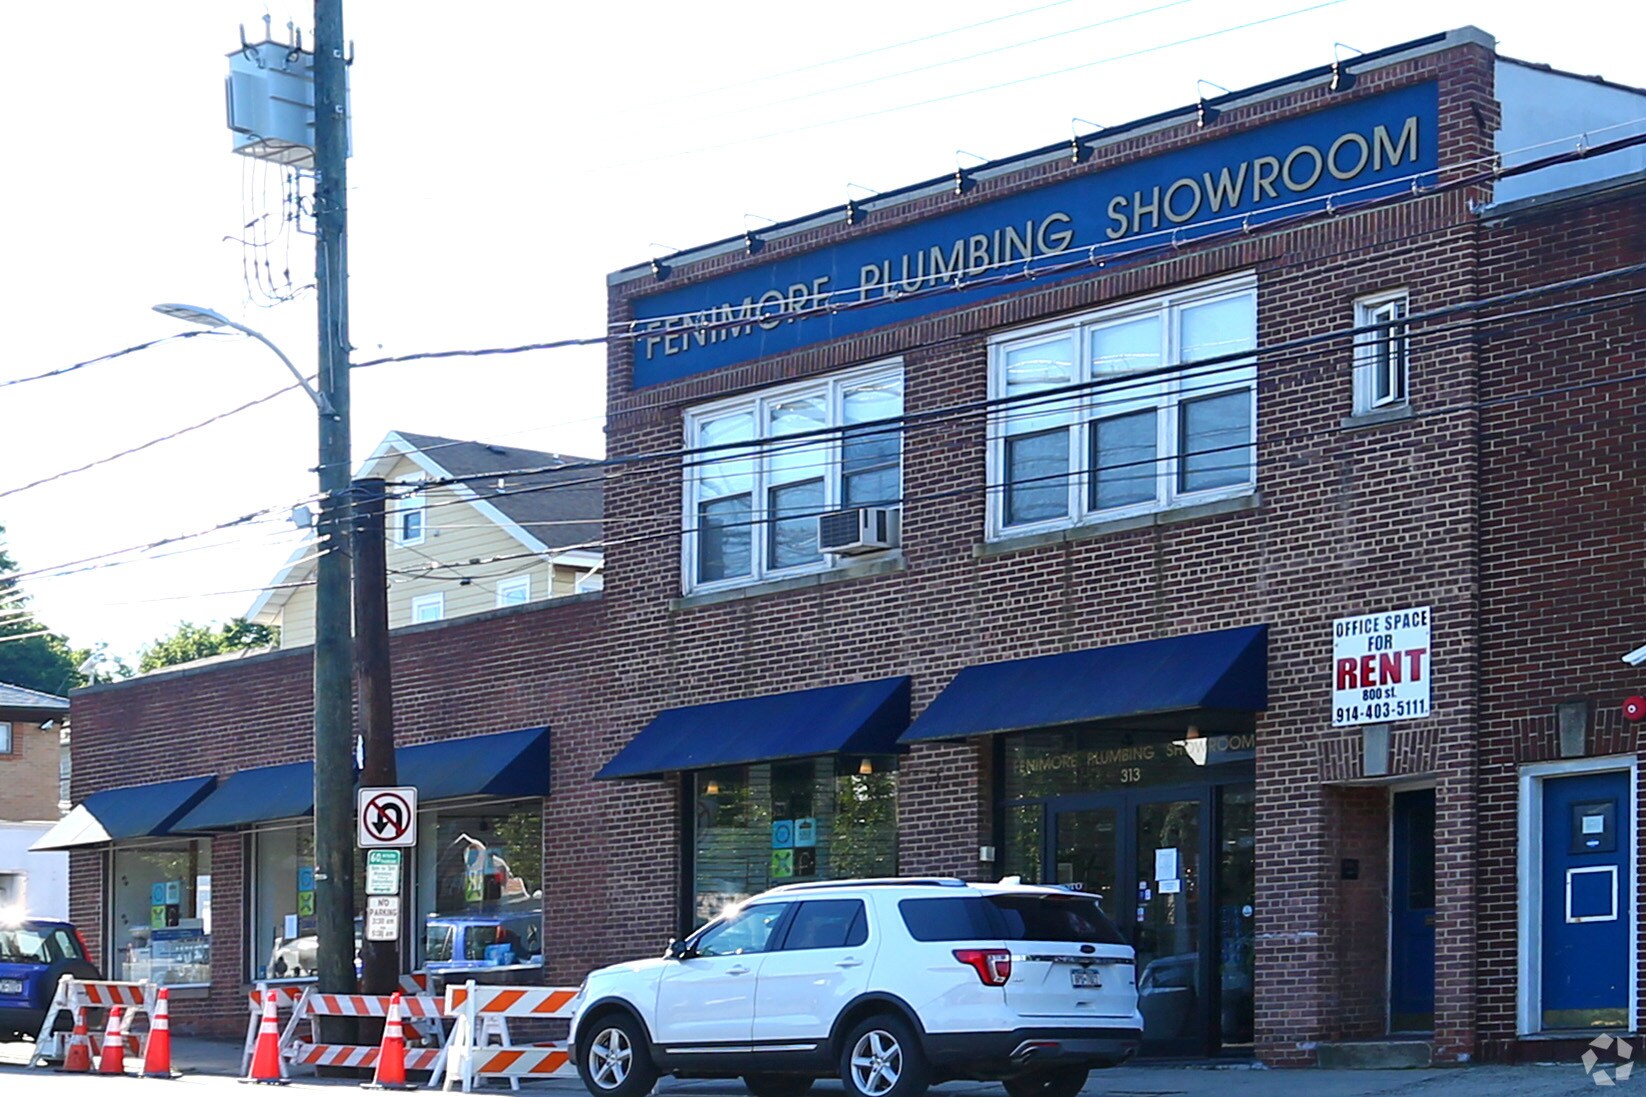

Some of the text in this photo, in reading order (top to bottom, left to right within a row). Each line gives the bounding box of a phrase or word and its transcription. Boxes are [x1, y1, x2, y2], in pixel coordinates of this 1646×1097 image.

[645, 115, 1419, 360] FENIMORE PLUMBING SHOWROOM
[1336, 610, 1427, 638] OFFICE SPACE
[1368, 634, 1393, 652] FOR
[1336, 647, 1427, 691] RENT
[1362, 688, 1382, 701] 800
[1336, 699, 1425, 722] 914-403-5111
[1014, 734, 1256, 774] FENIMORE PLUMBING SHOWROOM
[1120, 767, 1141, 783] 313
[369, 908, 398, 917] PARKING
[377, 899, 390, 907] NO
